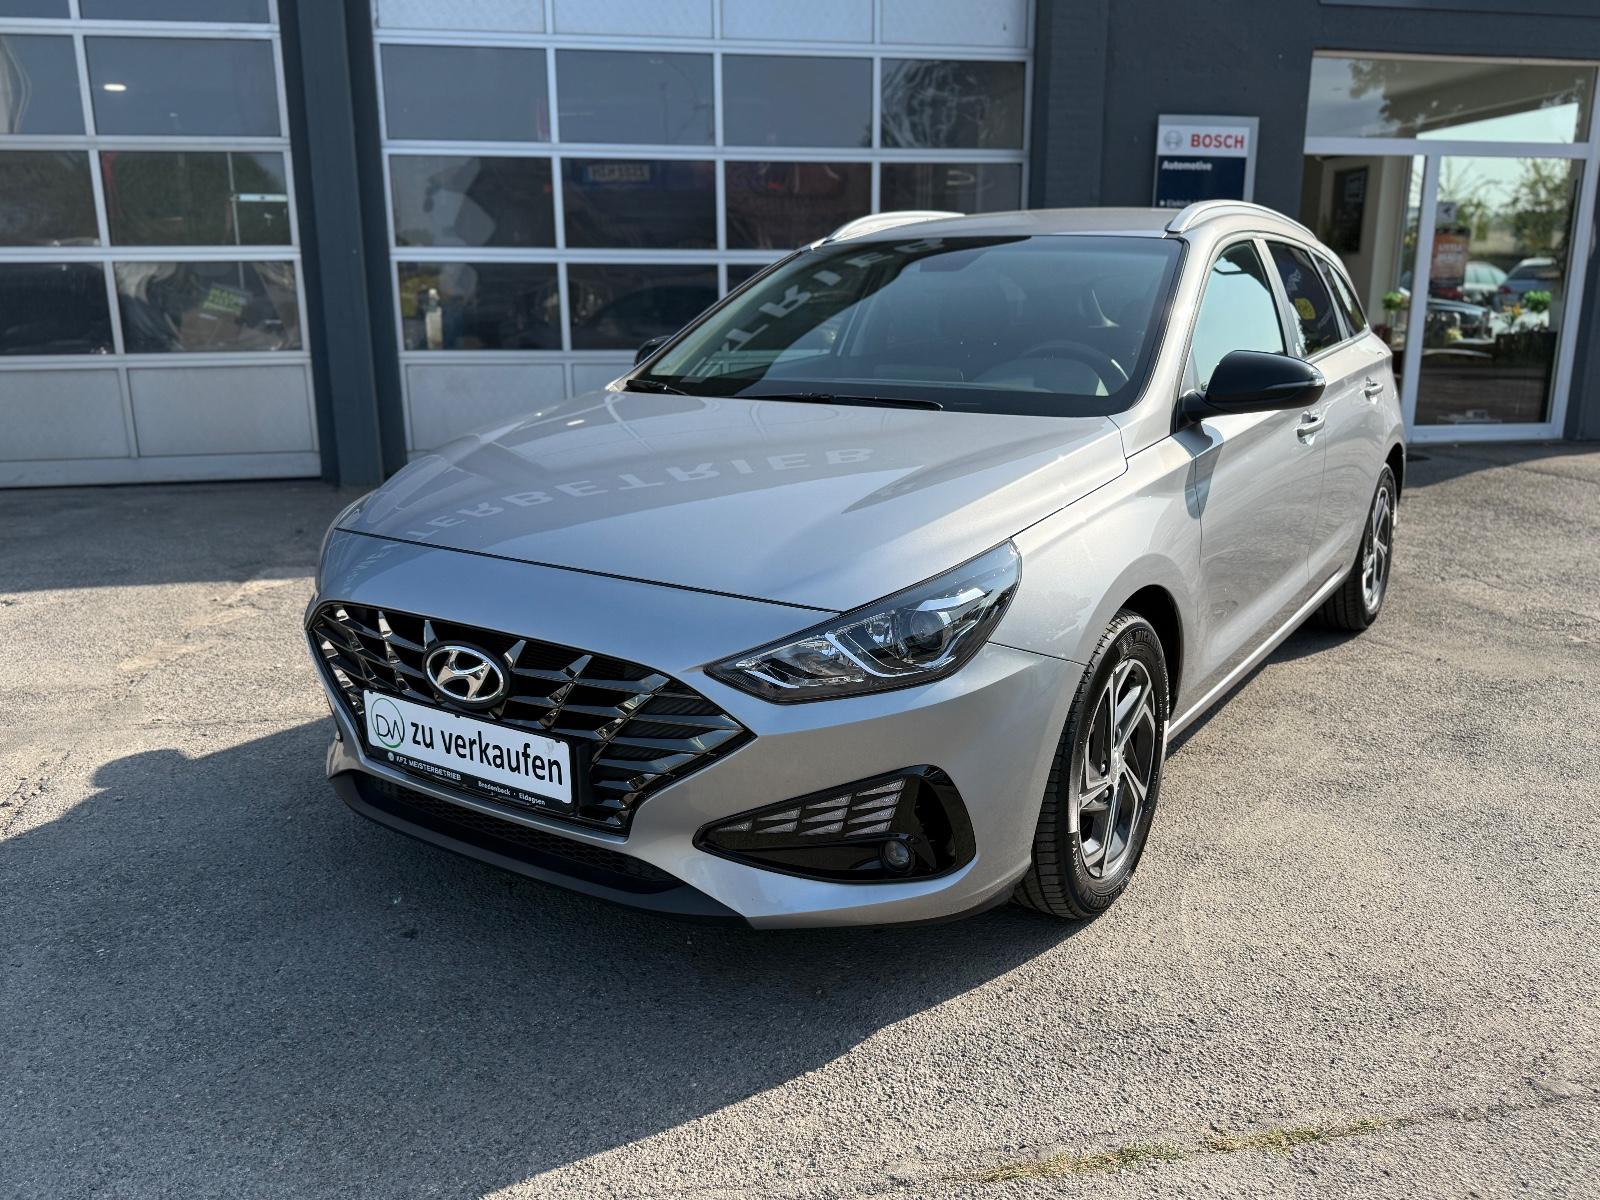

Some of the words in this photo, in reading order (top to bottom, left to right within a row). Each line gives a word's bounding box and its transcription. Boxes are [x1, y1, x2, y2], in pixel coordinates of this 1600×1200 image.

[1190, 133, 1244, 149] BOSCH
[1161, 160, 1213, 171] Automotive
[410, 721, 434, 750] zu
[440, 730, 563, 786] verkaufen
[408, 759, 462, 781] MEISTERBETRIEB
